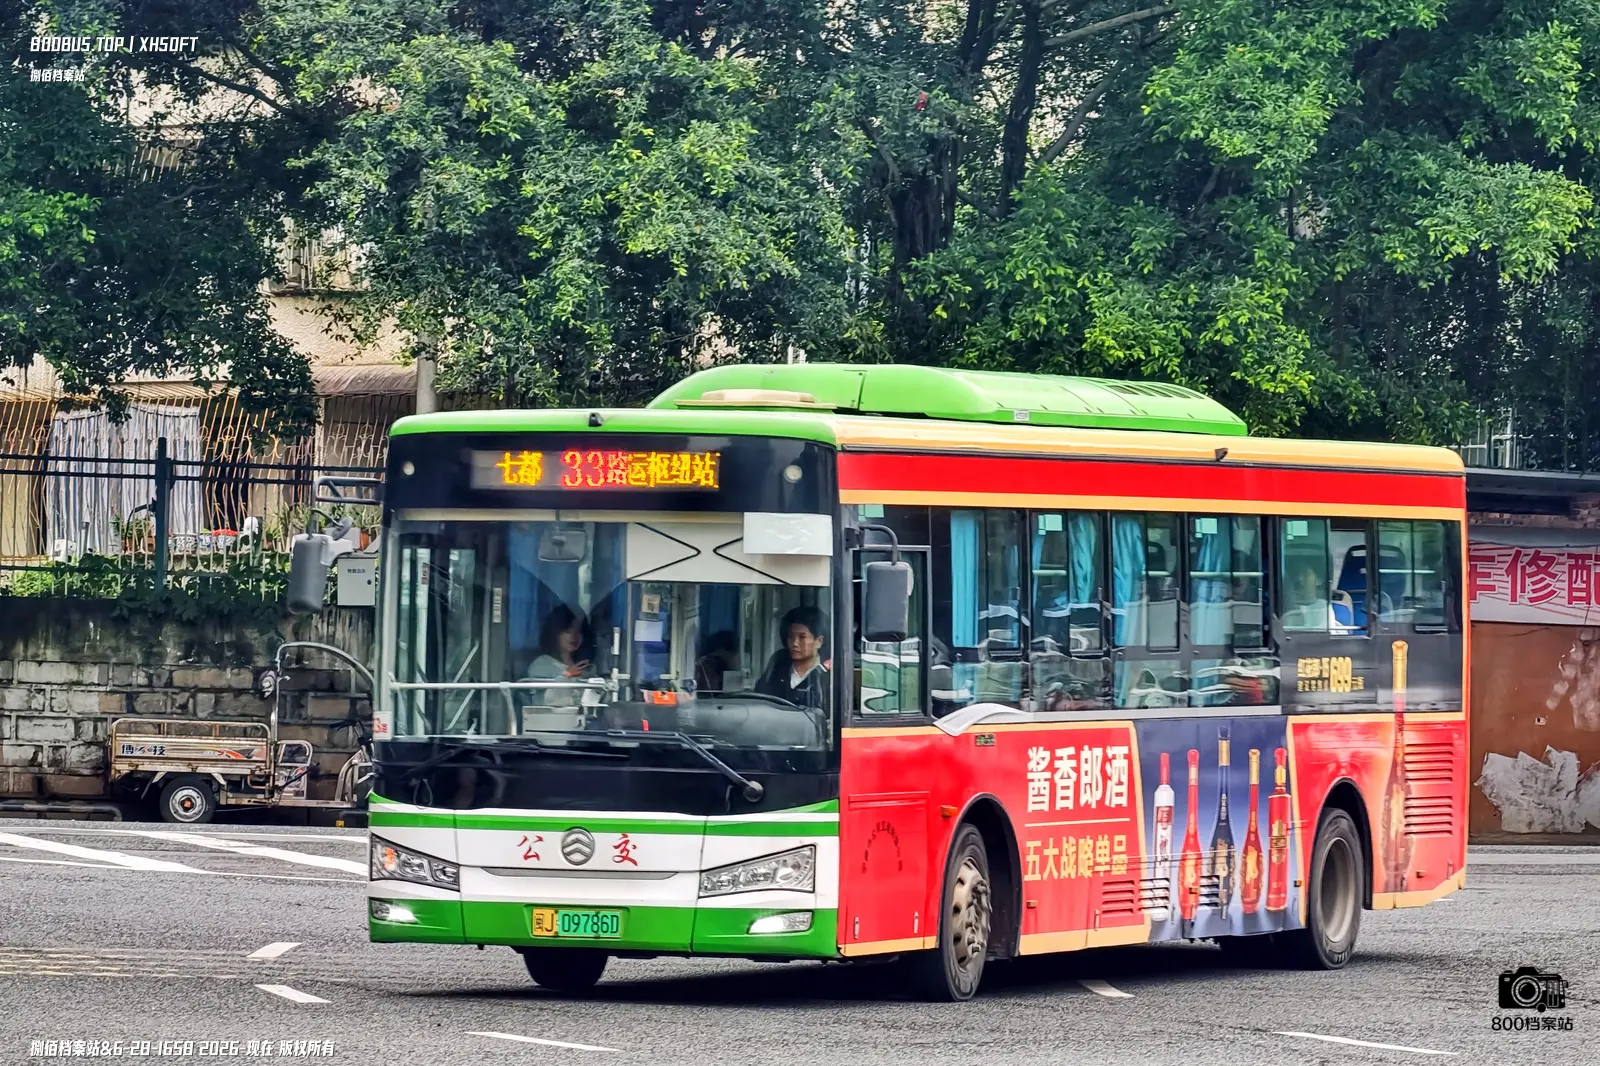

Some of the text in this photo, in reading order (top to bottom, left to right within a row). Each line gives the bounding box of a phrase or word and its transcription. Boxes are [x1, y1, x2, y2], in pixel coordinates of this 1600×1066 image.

[1026, 746, 1129, 813] 酱香郎酒
[517, 832, 639, 867] 公 交
[1023, 834, 1128, 881] 五大战略单品
[561, 913, 620, 934] 09786D
